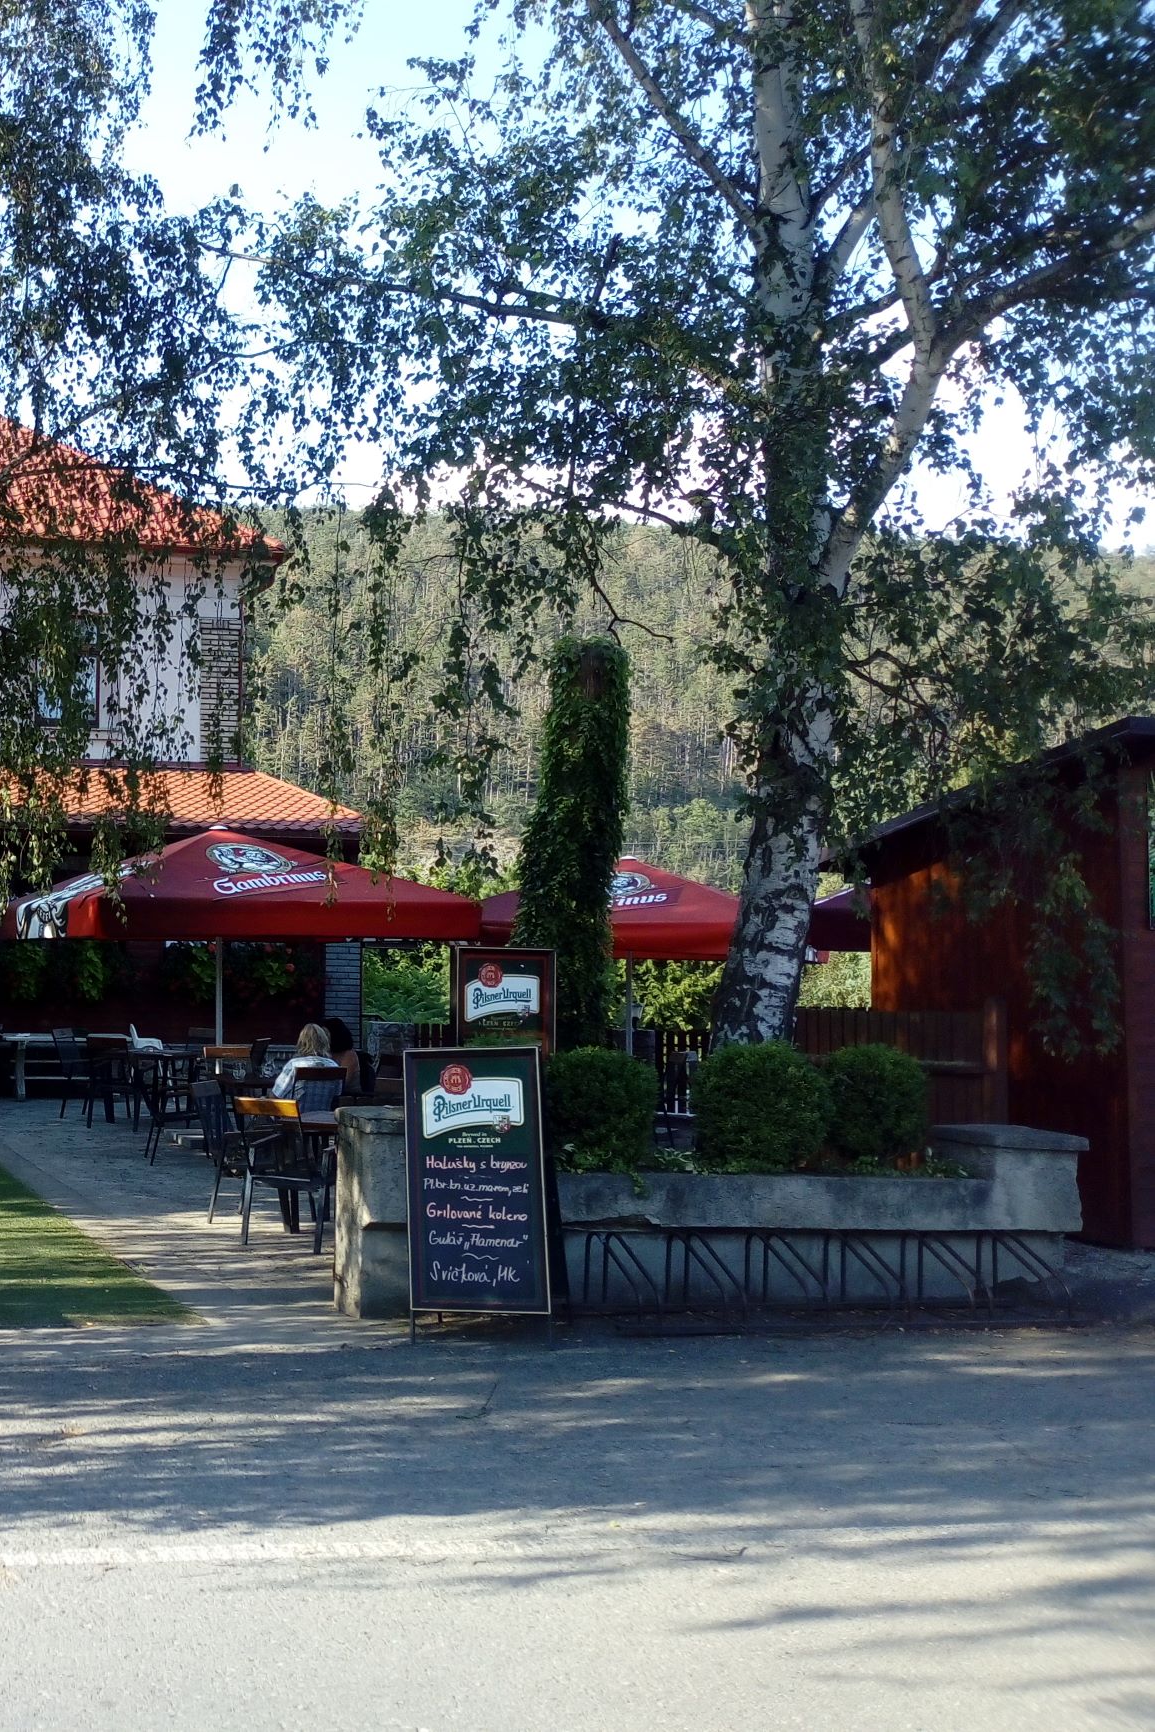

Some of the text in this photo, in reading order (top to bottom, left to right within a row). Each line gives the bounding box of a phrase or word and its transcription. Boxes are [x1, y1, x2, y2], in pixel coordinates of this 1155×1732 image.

[213, 870, 327, 894] Gambrinus
[472, 987, 532, 1010] Pilsner Urquell
[433, 1093, 511, 1123] Pilsner Urquell
[426, 1155, 476, 1173] Halušky
[480, 1160, 486, 1169] s
[426, 1202, 528, 1221] Grilované koleno
